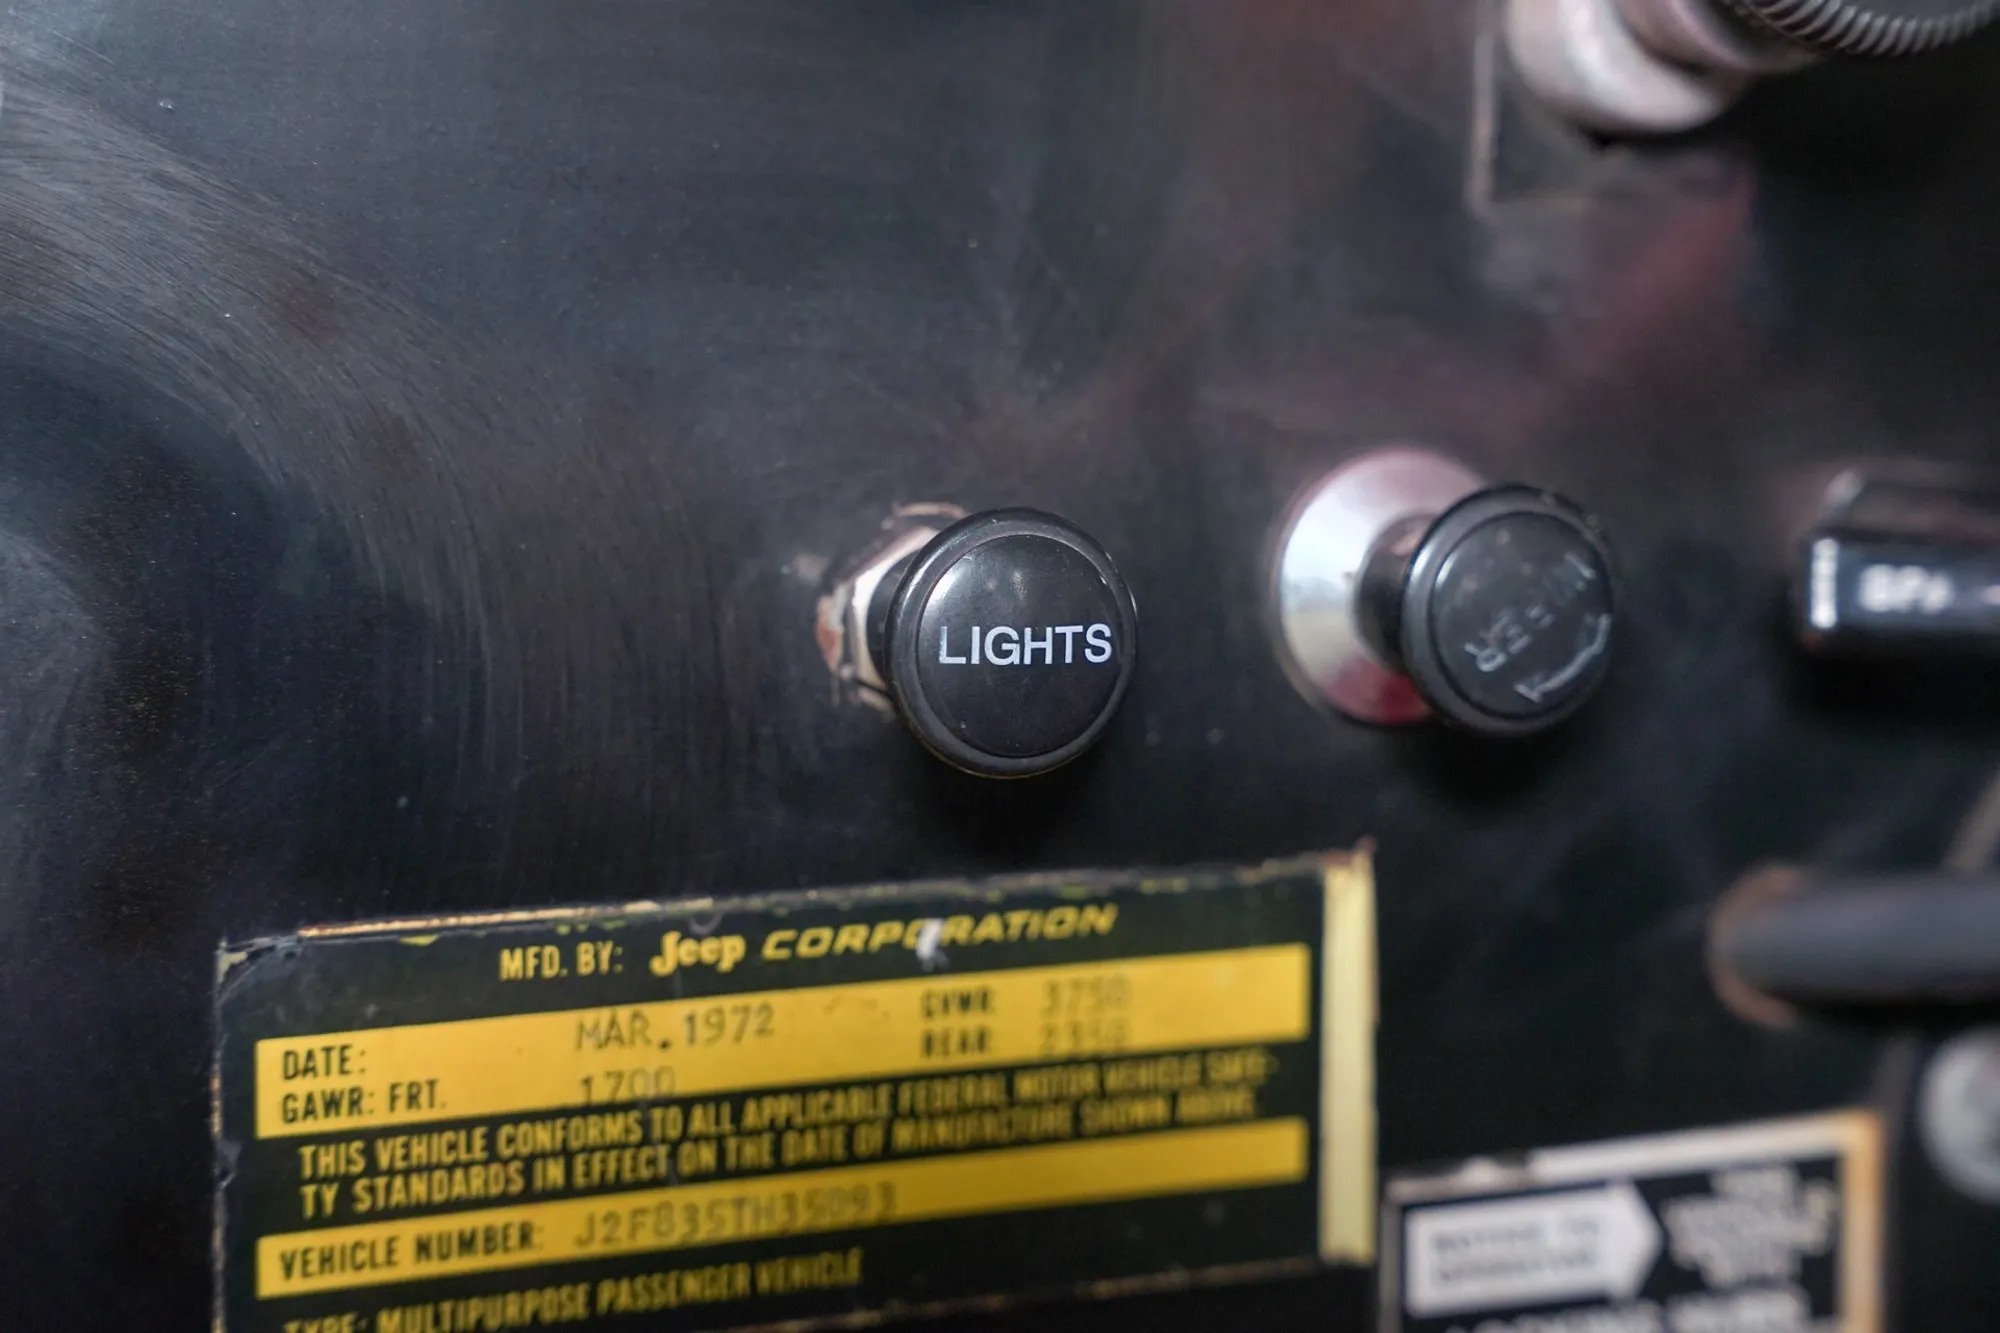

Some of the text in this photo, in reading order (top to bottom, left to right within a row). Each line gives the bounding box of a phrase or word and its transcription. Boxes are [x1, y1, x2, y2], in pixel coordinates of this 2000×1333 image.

[938, 623, 1112, 666] LIGHTS
[499, 945, 568, 981] MFD.
[576, 940, 624, 976] BY:
[650, 930, 747, 977] Jeep
[283, 1044, 366, 1080] DATE:
[281, 1085, 375, 1124] GAWR:
[581, 1066, 676, 1105] 1700
[299, 1139, 366, 1180] THIS
[374, 1126, 490, 1173] VEHICLE
[496, 1110, 643, 1159] CONFORMS
[650, 1105, 683, 1143] TO
[687, 1101, 735, 1137] ALL
[741, 1083, 893, 1131] APPLICABLE
[897, 1072, 1006, 1117] FEDERAL
[1013, 1062, 1098, 1102] MOTOR
[1102, 1053, 1202, 1096] VEHICLE
[299, 1183, 338, 1220] TY
[352, 1159, 525, 1214] STANDARDS
[533, 1155, 566, 1195] IN
[571, 1143, 671, 1189] EFFECT
[676, 1139, 718, 1178] ON
[724, 1130, 774, 1172] THE
[780, 1124, 848, 1168] DATE
[853, 1118, 887, 1159] OF
[890, 1103, 1075, 1152] MANUFACTURE
[279, 1236, 399, 1281] VEHICLE
[376, 1283, 592, 1333] MULTIPURPOSE
[596, 1261, 750, 1316] PASSENGER
[754, 1246, 864, 1296] VEHICLE
